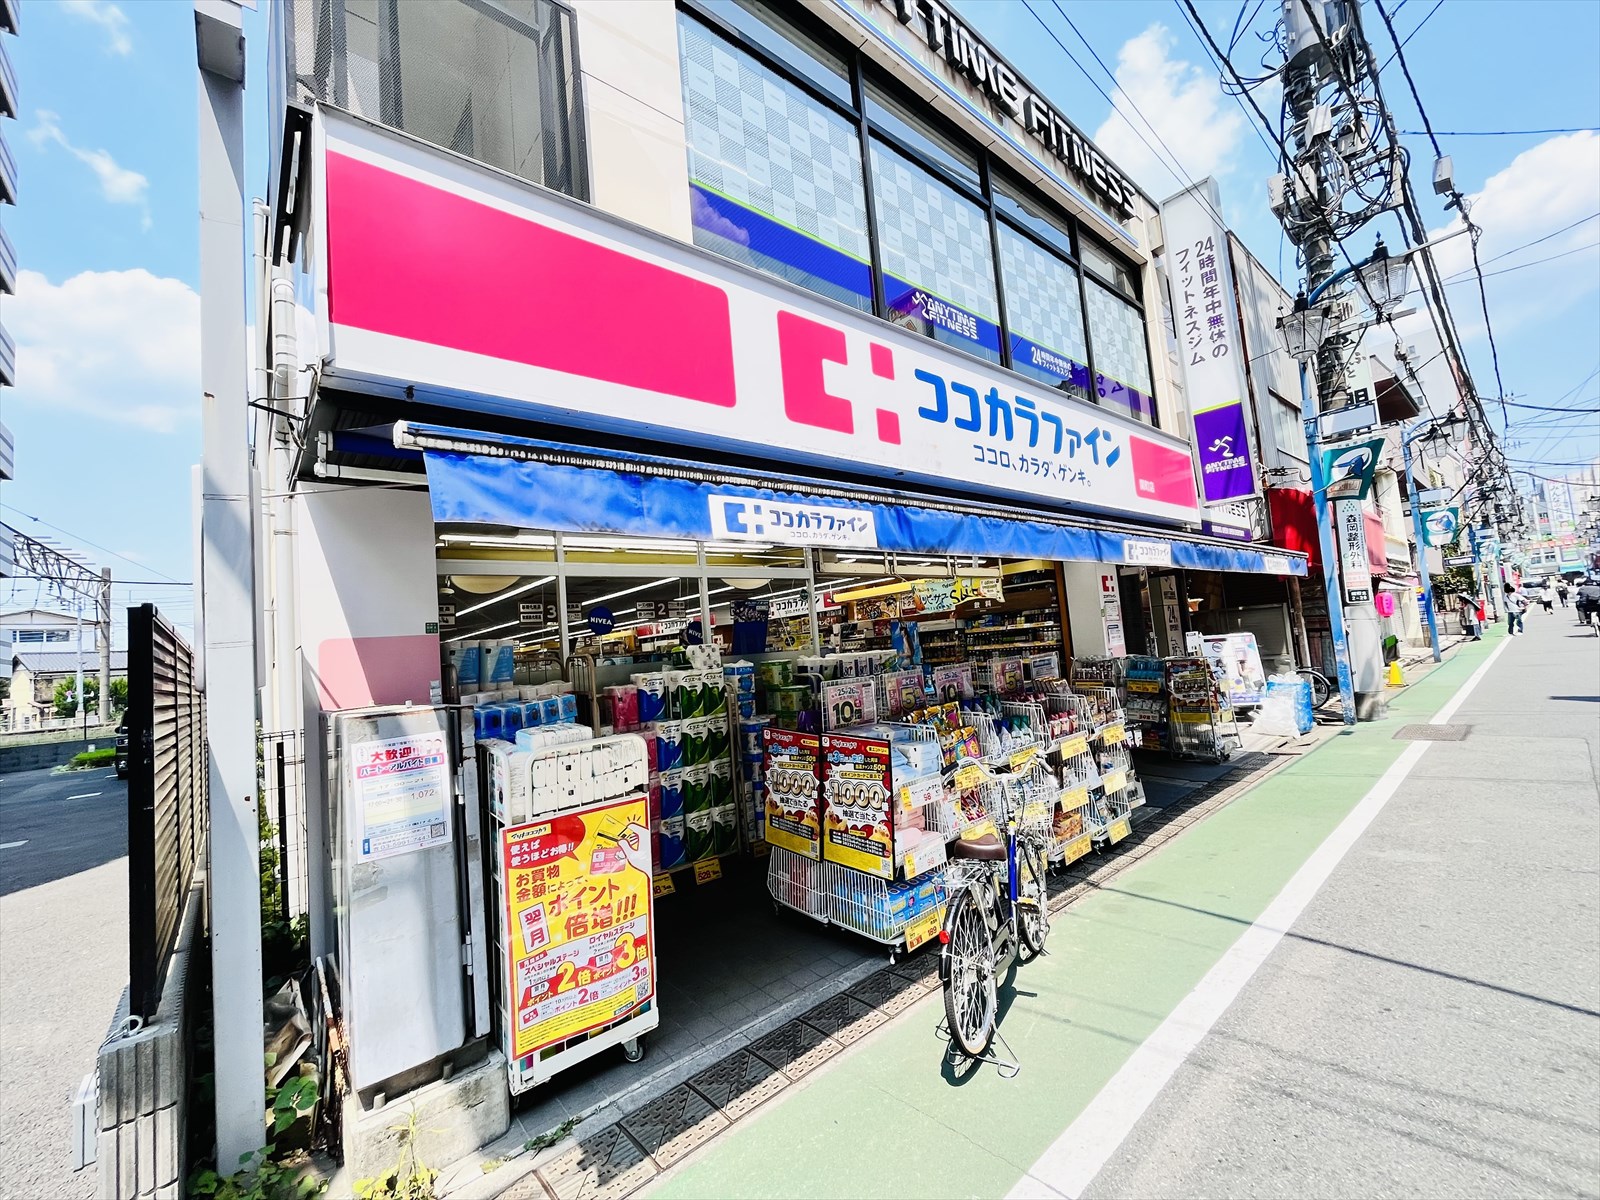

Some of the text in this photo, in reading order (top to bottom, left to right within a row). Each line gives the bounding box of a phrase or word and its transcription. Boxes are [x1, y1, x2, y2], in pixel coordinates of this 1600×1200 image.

[1026, 94, 1137, 218] FITNESS
[926, 297, 977, 327] ANYTIME
[1175, 247, 1206, 366] フィットネスジム
[1194, 236, 1229, 358] 24時間年中無休の
[928, 310, 979, 340] FITNESS
[914, 367, 1121, 468] ココカラファイン
[973, 444, 1093, 487] ココロ、カラダ、ゲンキ。
[769, 509, 868, 533] ココカラファイン
[547, 605, 557, 619] 3
[590, 616, 613, 626] NIVEA
[658, 603, 667, 616] 2
[510, 839, 541, 856] 使えば
[510, 842, 575, 867] 使うほどお得!!
[516, 864, 560, 888] お買物
[549, 878, 620, 917] ポイント
[523, 908, 546, 948] 翌月
[564, 893, 638, 940] 倍増!!!
[589, 921, 635, 945] ロイヤルステージ
[524, 949, 580, 976] スペシャルステージ
